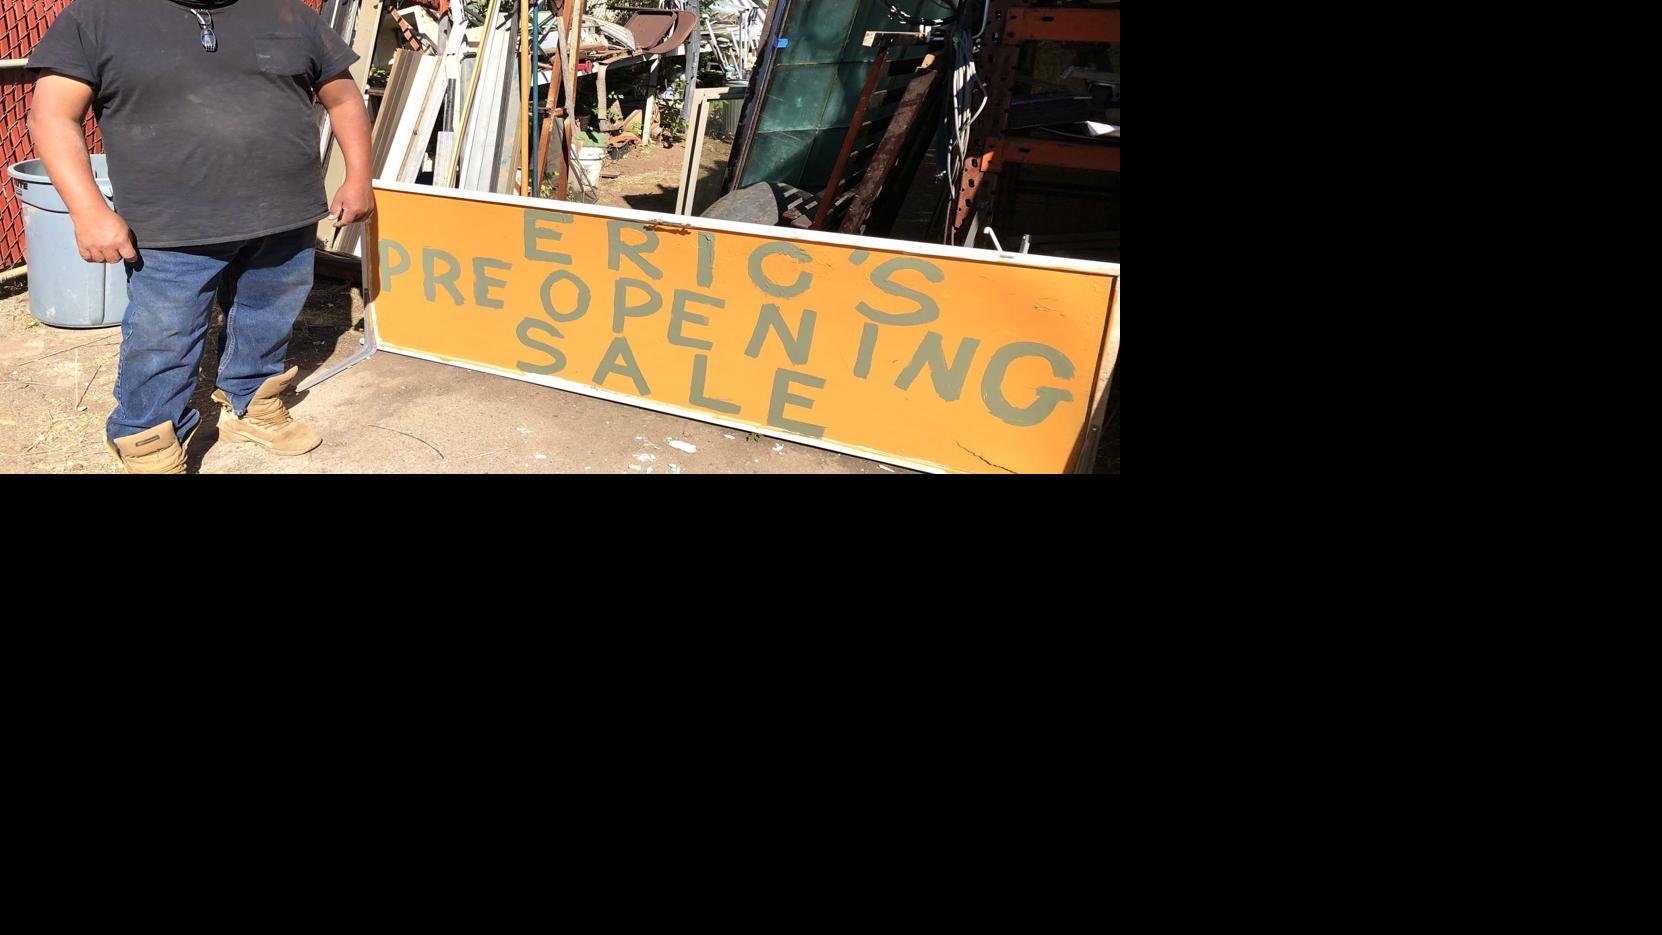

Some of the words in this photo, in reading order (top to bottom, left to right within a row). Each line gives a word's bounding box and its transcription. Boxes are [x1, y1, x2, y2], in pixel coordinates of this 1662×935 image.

[523, 208, 944, 326] ERIC'S
[379, 238, 512, 310] PRE
[540, 269, 1076, 426] OPENING
[516, 317, 827, 440] SALE
